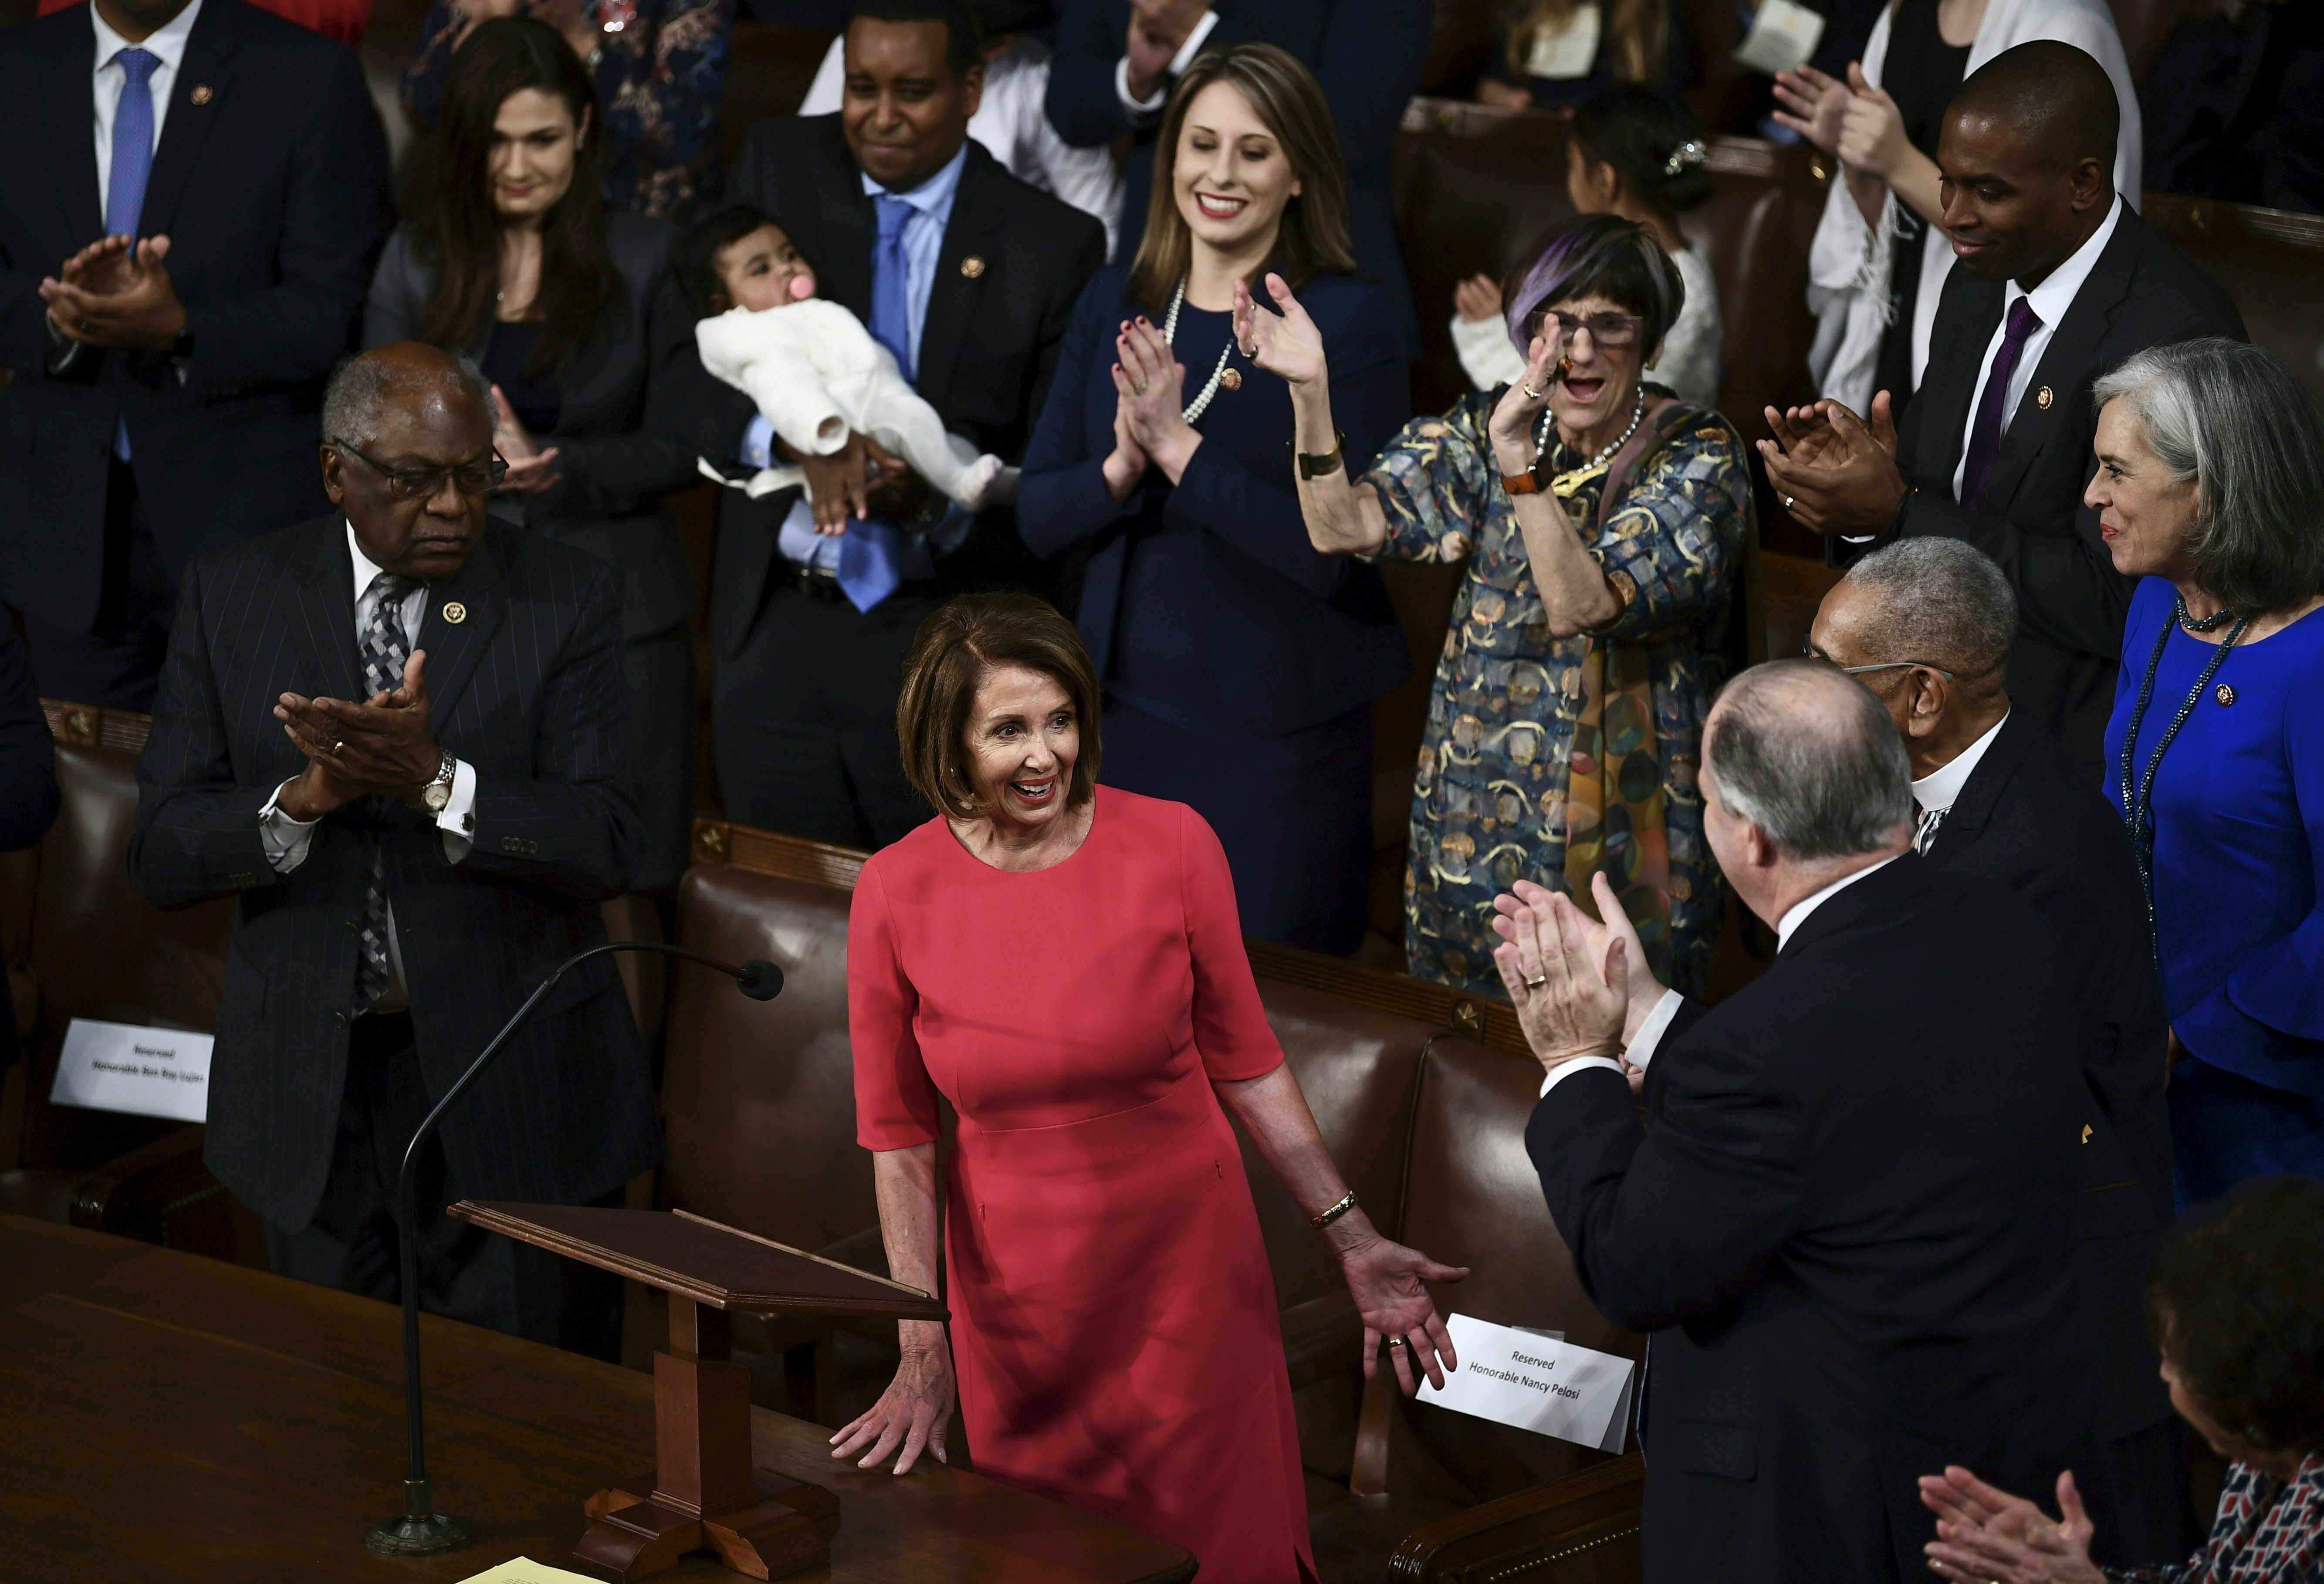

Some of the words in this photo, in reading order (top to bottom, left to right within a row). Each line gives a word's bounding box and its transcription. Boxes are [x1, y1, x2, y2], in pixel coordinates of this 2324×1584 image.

[1512, 1351, 1555, 1370] Reserved
[1469, 1361, 1519, 1383] Honorable
[1520, 1376, 1550, 1394] Nancy
[1551, 1384, 1580, 1399] Pelosi
